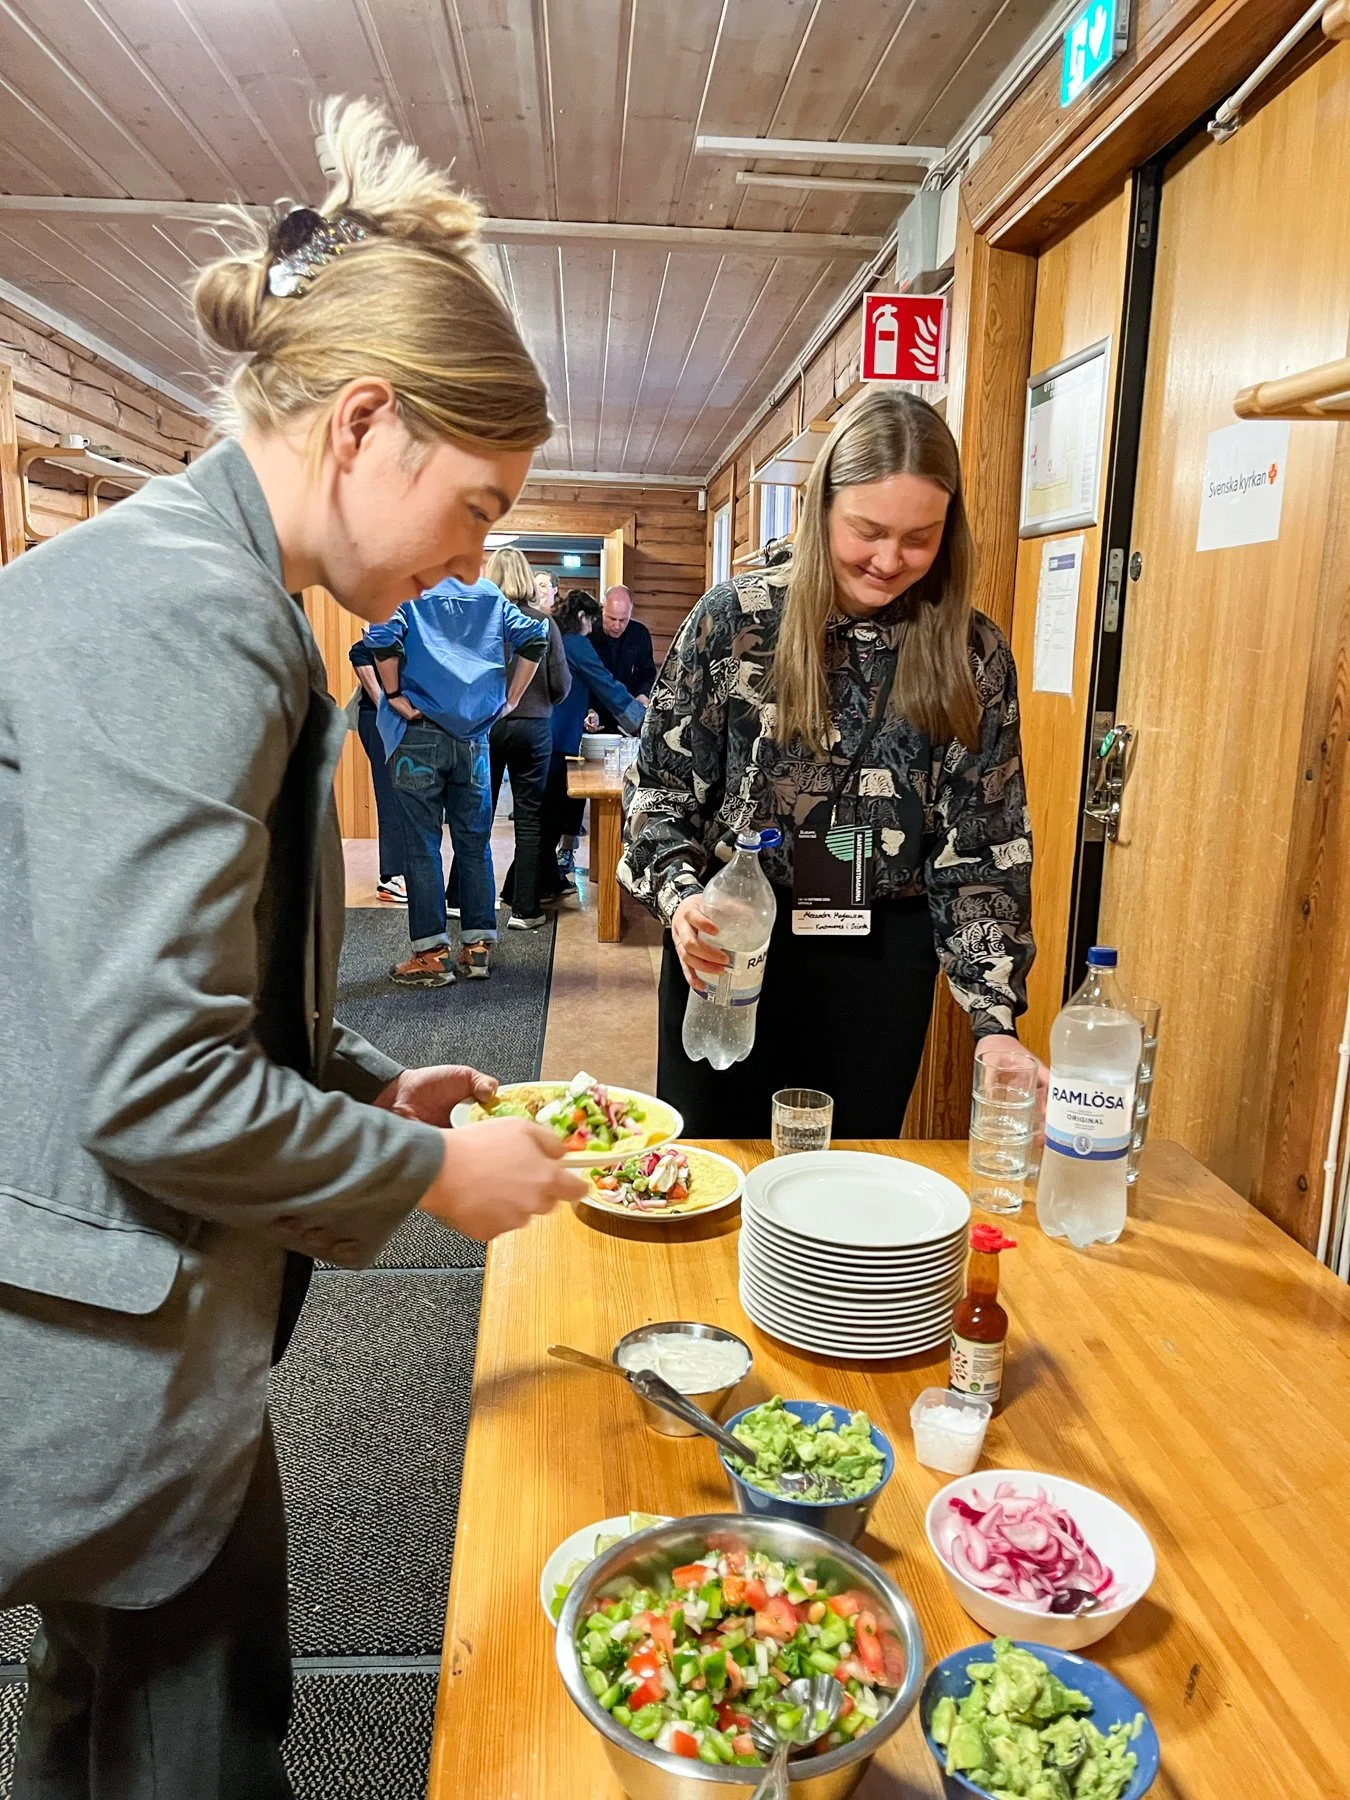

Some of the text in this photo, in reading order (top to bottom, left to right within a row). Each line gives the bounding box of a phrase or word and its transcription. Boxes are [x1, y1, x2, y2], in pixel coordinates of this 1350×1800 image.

[1208, 469, 1267, 498] Svenska kyrkan
[1052, 1087, 1125, 1110] RAMLÖSA
[1066, 1114, 1104, 1125] ORIGINAL
